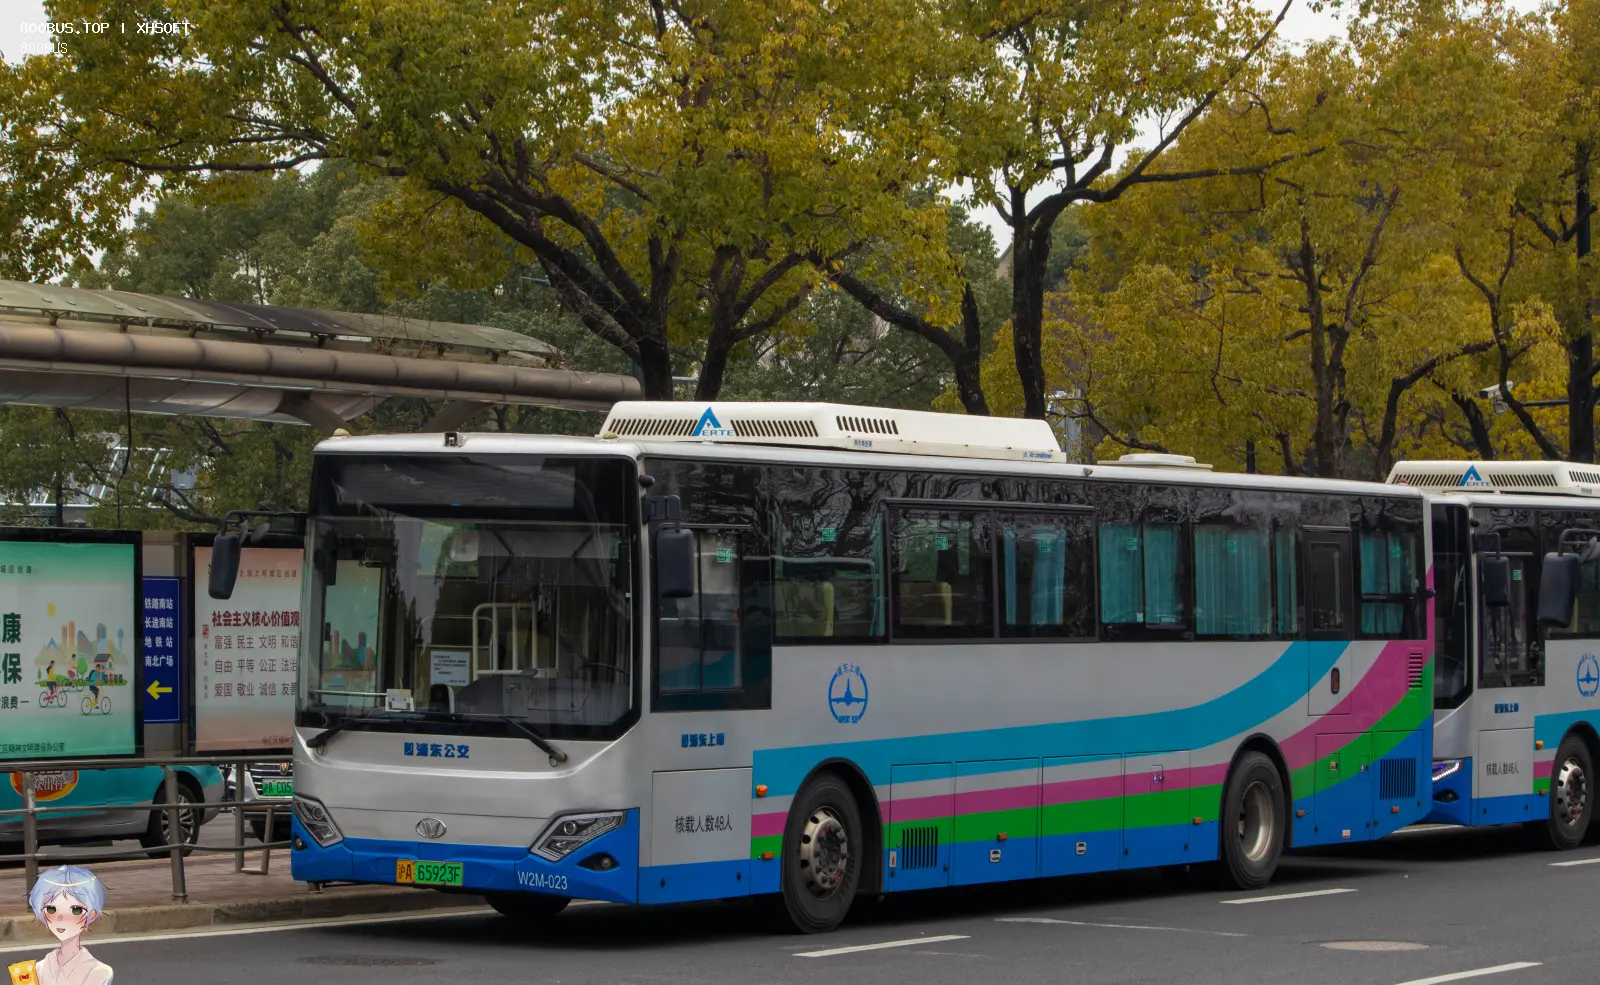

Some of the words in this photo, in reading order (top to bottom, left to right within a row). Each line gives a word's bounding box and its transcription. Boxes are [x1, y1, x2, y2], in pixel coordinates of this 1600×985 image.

[144, 598, 174, 610] 铁路南站
[144, 616, 174, 629] 长途南站
[212, 610, 300, 627] 社会主义核心价值观
[214, 634, 233, 650] 富强
[237, 634, 255, 649] 民主
[259, 634, 277, 649] 文明
[281, 634, 299, 649] 和谐
[144, 655, 174, 667] 南北广场
[214, 659, 233, 674] 自由
[237, 659, 255, 675] 平等
[259, 659, 277, 673] 公正
[214, 682, 233, 697] 爱国
[237, 682, 255, 697] 敬业
[259, 682, 277, 697] 诚信
[416, 742, 470, 758] 浦东公交
[675, 813, 733, 834] 核载人数48人
[517, 871, 569, 890] W2M-023
